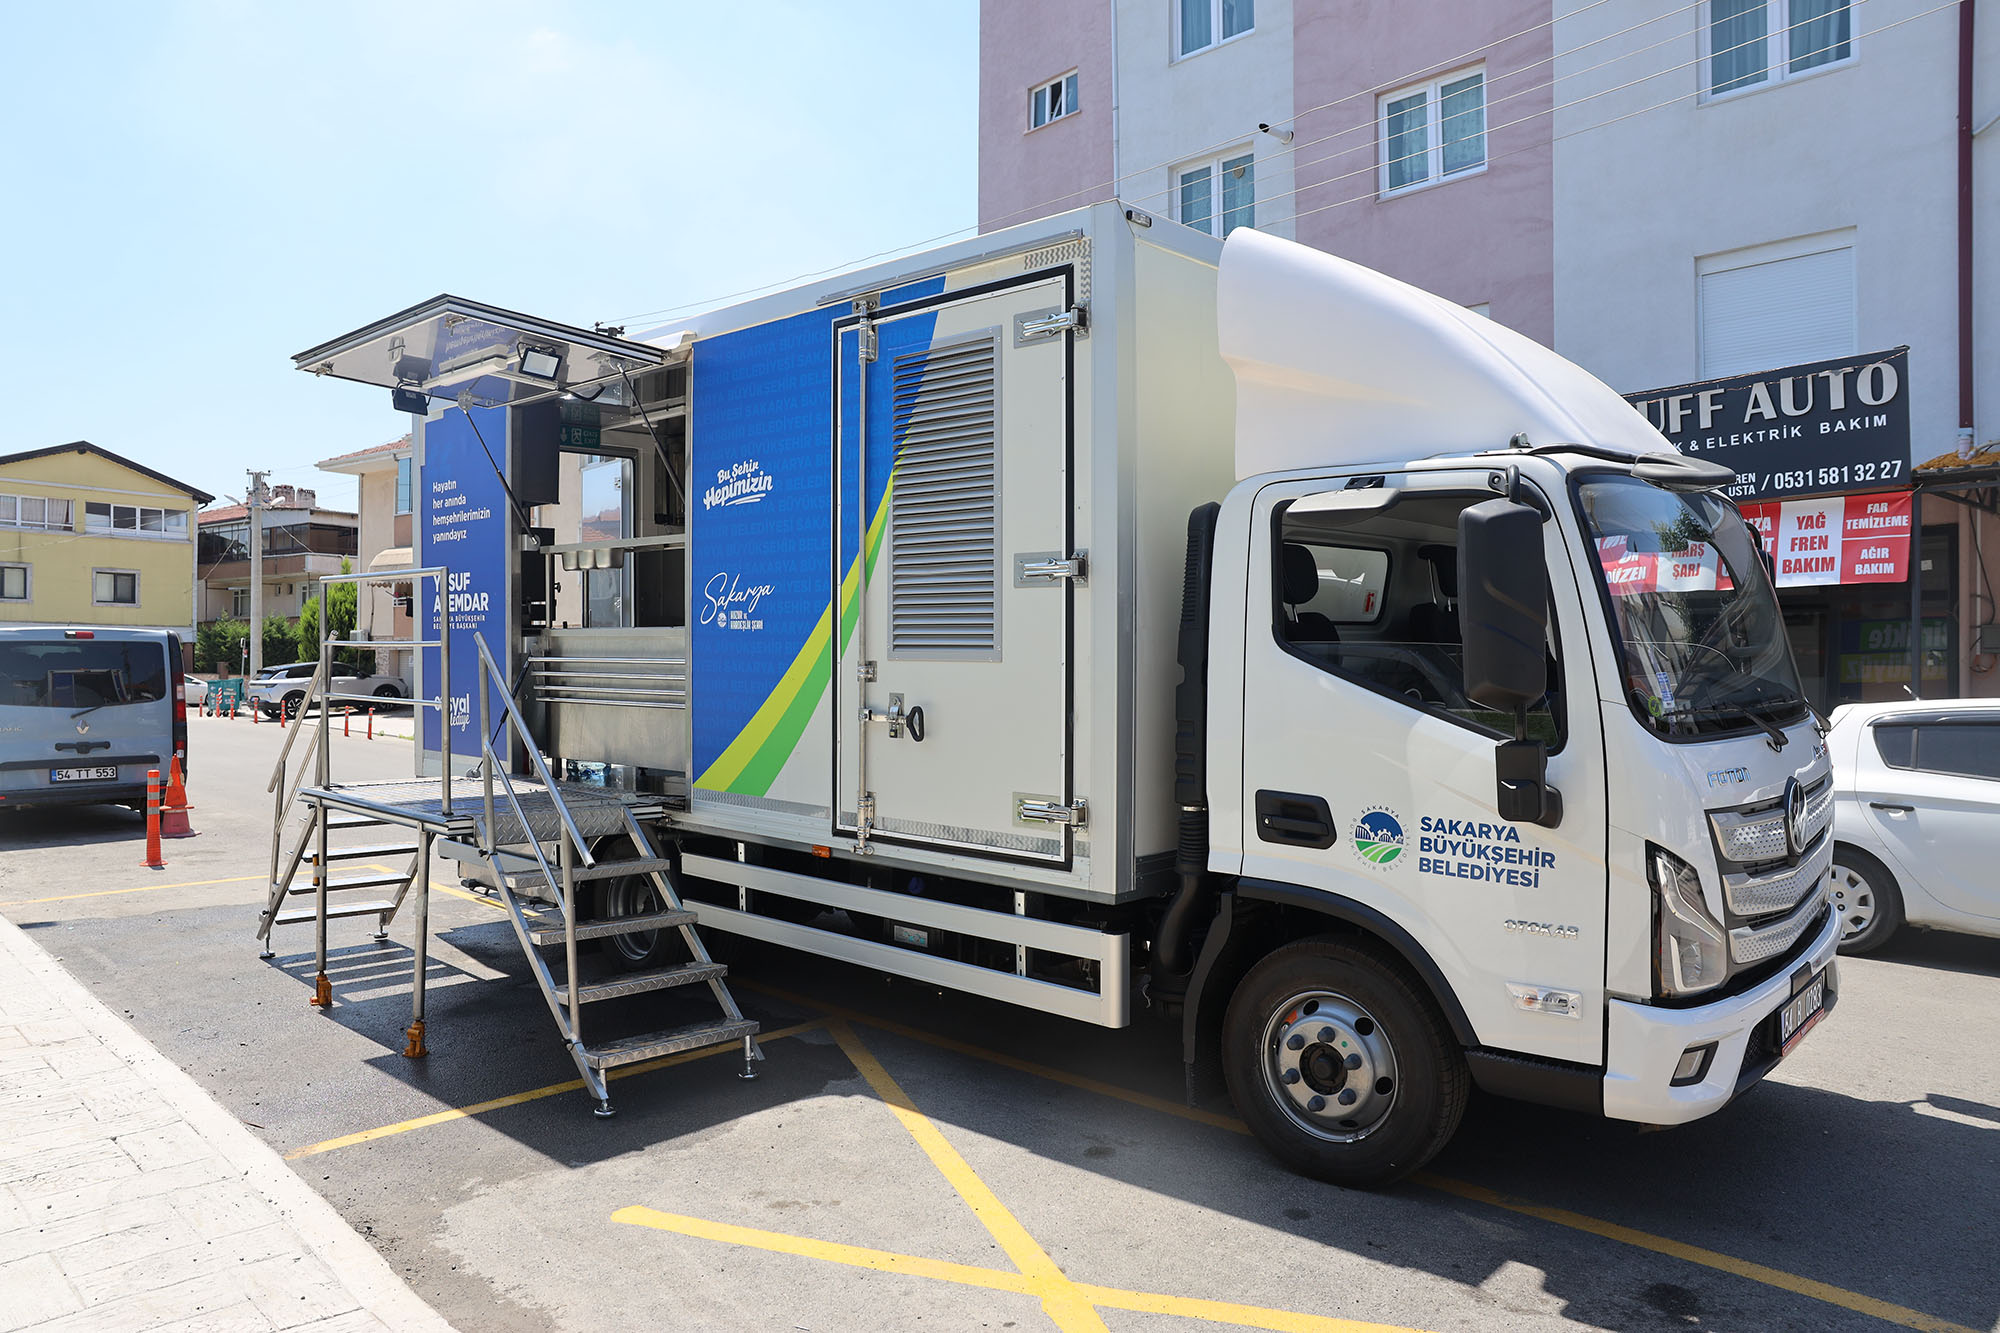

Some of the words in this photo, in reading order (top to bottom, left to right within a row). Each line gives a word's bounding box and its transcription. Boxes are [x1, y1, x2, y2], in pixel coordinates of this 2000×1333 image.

[1743, 362, 1899, 423] AUTO
[1706, 424, 1802, 449] ELEKTRİK
[1820, 414, 1888, 434] BAKIM
[717, 469, 731, 484] Bu
[732, 459, 759, 481] Şehir
[1774, 470, 1813, 490] 0531
[1818, 466, 1849, 485] 581
[1854, 463, 1875, 482] 32
[1880, 460, 1902, 479] 27
[432, 480, 457, 494] Hayatın
[703, 471, 773, 510] Hepimizin
[1728, 485, 1756, 497] USTA
[432, 499, 443, 509] her
[444, 494, 467, 508] anında
[1867, 502, 1889, 514] FAR
[432, 507, 491, 526] hemşehrilerimizin
[1796, 511, 1827, 530] YAĞ
[1845, 515, 1909, 530] TEMİZLEME
[432, 529, 467, 545] yanındayız
[1790, 535, 1829, 552] FREN
[1860, 546, 1890, 560] AĞIR
[1672, 563, 1701, 580] ŞARJ
[1782, 556, 1836, 574] BAKIM
[1854, 563, 1895, 576] BAKIM
[433, 572, 471, 593] YSUF
[433, 592, 489, 613] AEMDAR
[700, 572, 776, 624] Sakarya
[57, 770, 70, 780] 54
[76, 769, 91, 778] TT
[95, 767, 115, 777] 553
[1419, 816, 1520, 843] SAKARYA
[1419, 835, 1556, 869] BÜYÜKŞEHİR
[1418, 856, 1540, 889] BELEDİYESİ
[1503, 919, 1580, 940] OTOKAR
